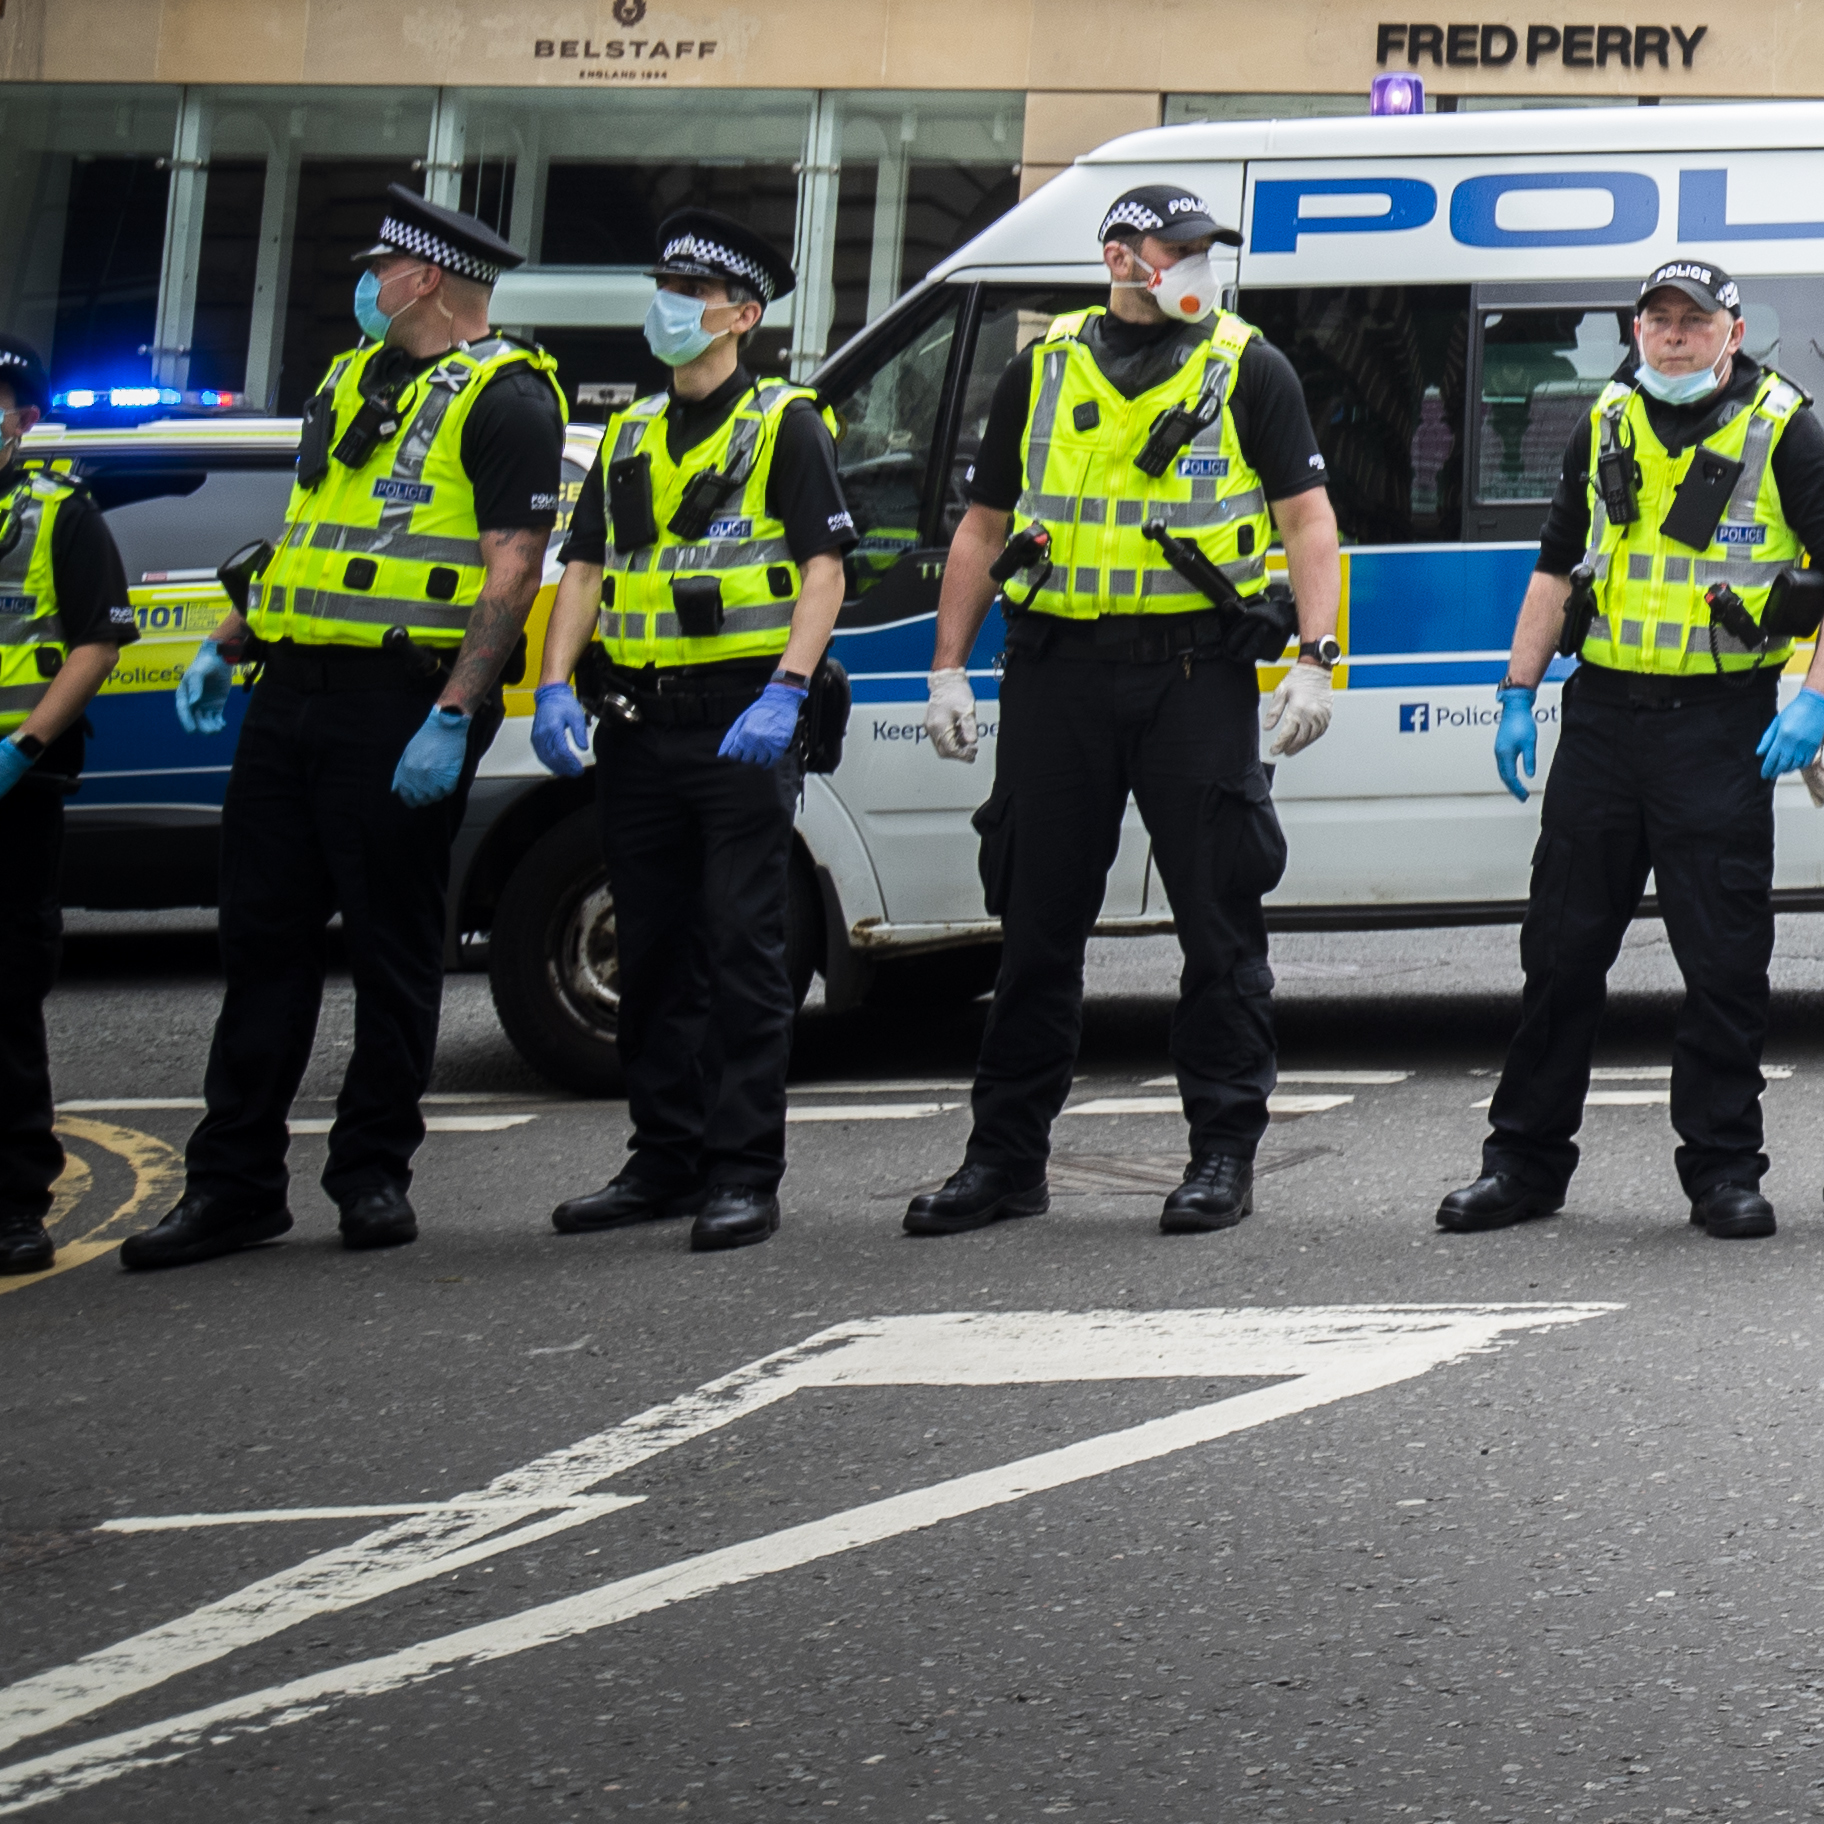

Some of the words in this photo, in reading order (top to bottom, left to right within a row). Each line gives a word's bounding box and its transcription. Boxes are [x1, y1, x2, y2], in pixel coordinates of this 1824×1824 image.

[534, 40, 718, 60] BELSTAFF
[1376, 23, 1519, 67] FRED
[1526, 24, 1708, 69] PERRY
[578, 69, 637, 80] ENGLAND
[1656, 264, 1712, 285] POLICE
[1181, 458, 1227, 476] POLICE
[377, 481, 430, 502] POLICE
[1718, 526, 1763, 544] POLICE
[137, 606, 185, 630] 101
